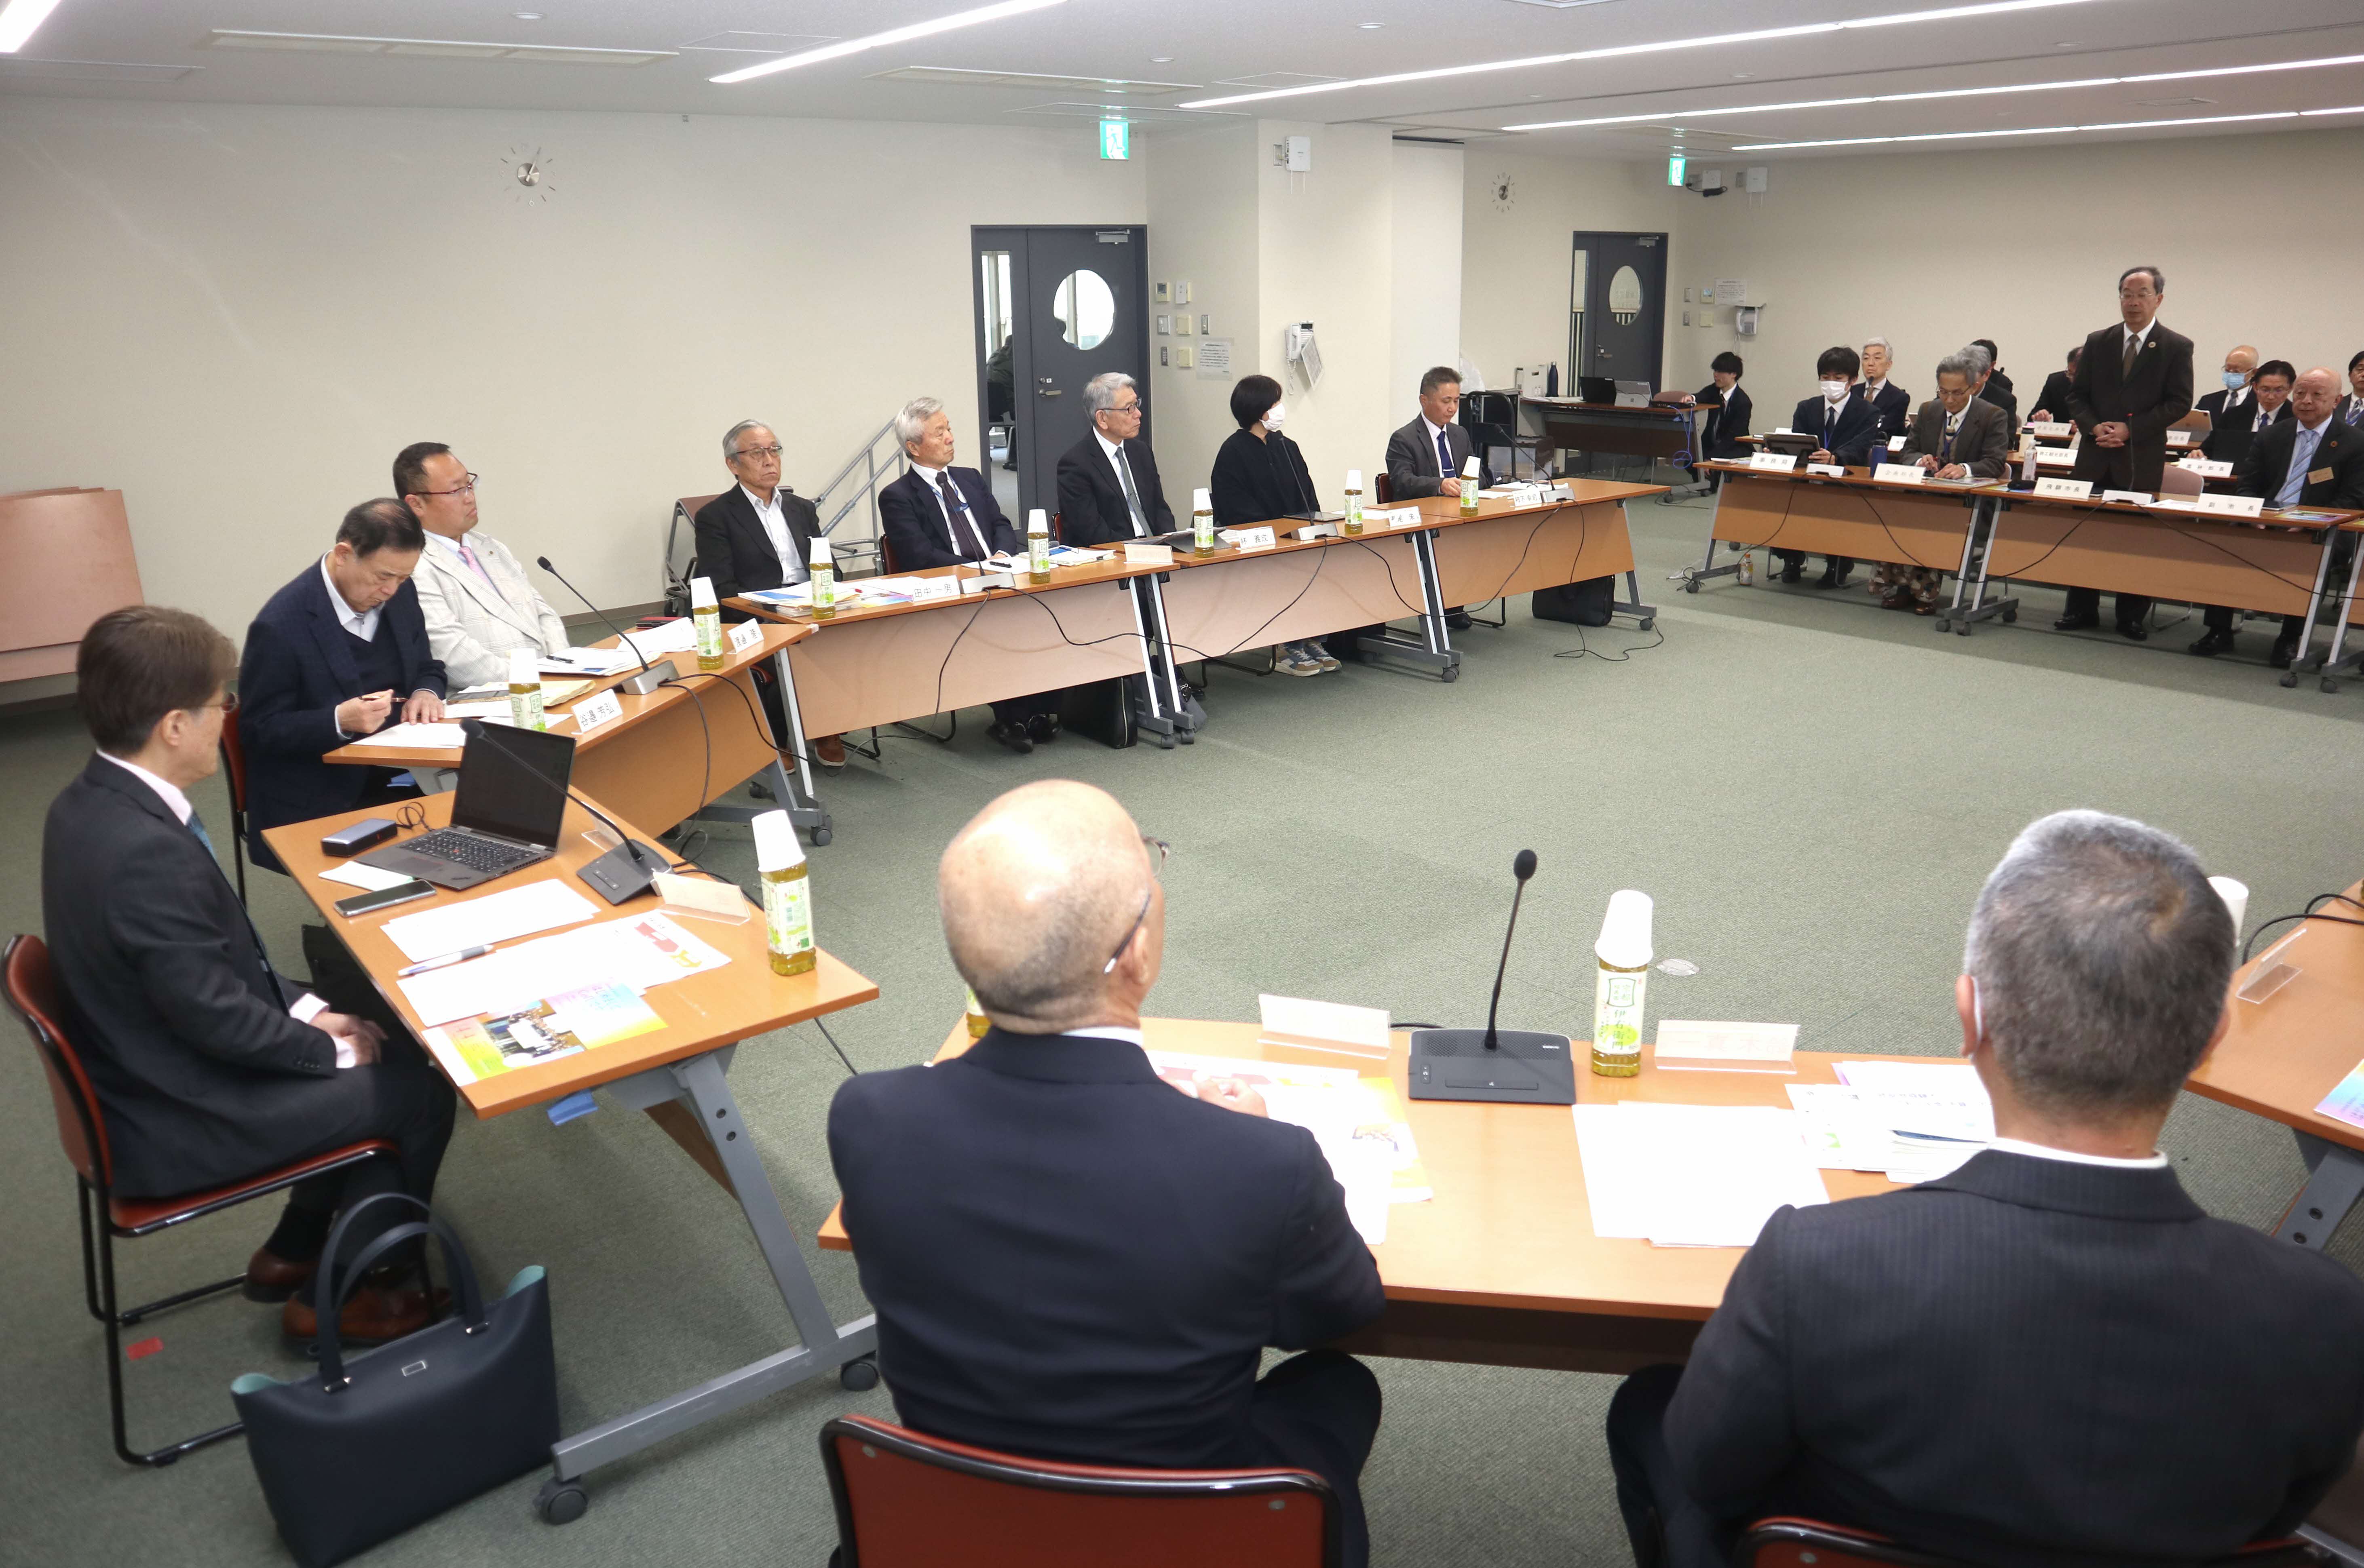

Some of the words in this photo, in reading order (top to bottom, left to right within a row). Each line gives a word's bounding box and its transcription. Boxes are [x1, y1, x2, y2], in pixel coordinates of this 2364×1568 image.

[2046, 484, 2080, 492] 飛騨市長
[2208, 502, 2254, 511] 副市長
[914, 584, 952, 598] 田中一男
[1612, 1010, 1626, 1050] 伊右衛門
